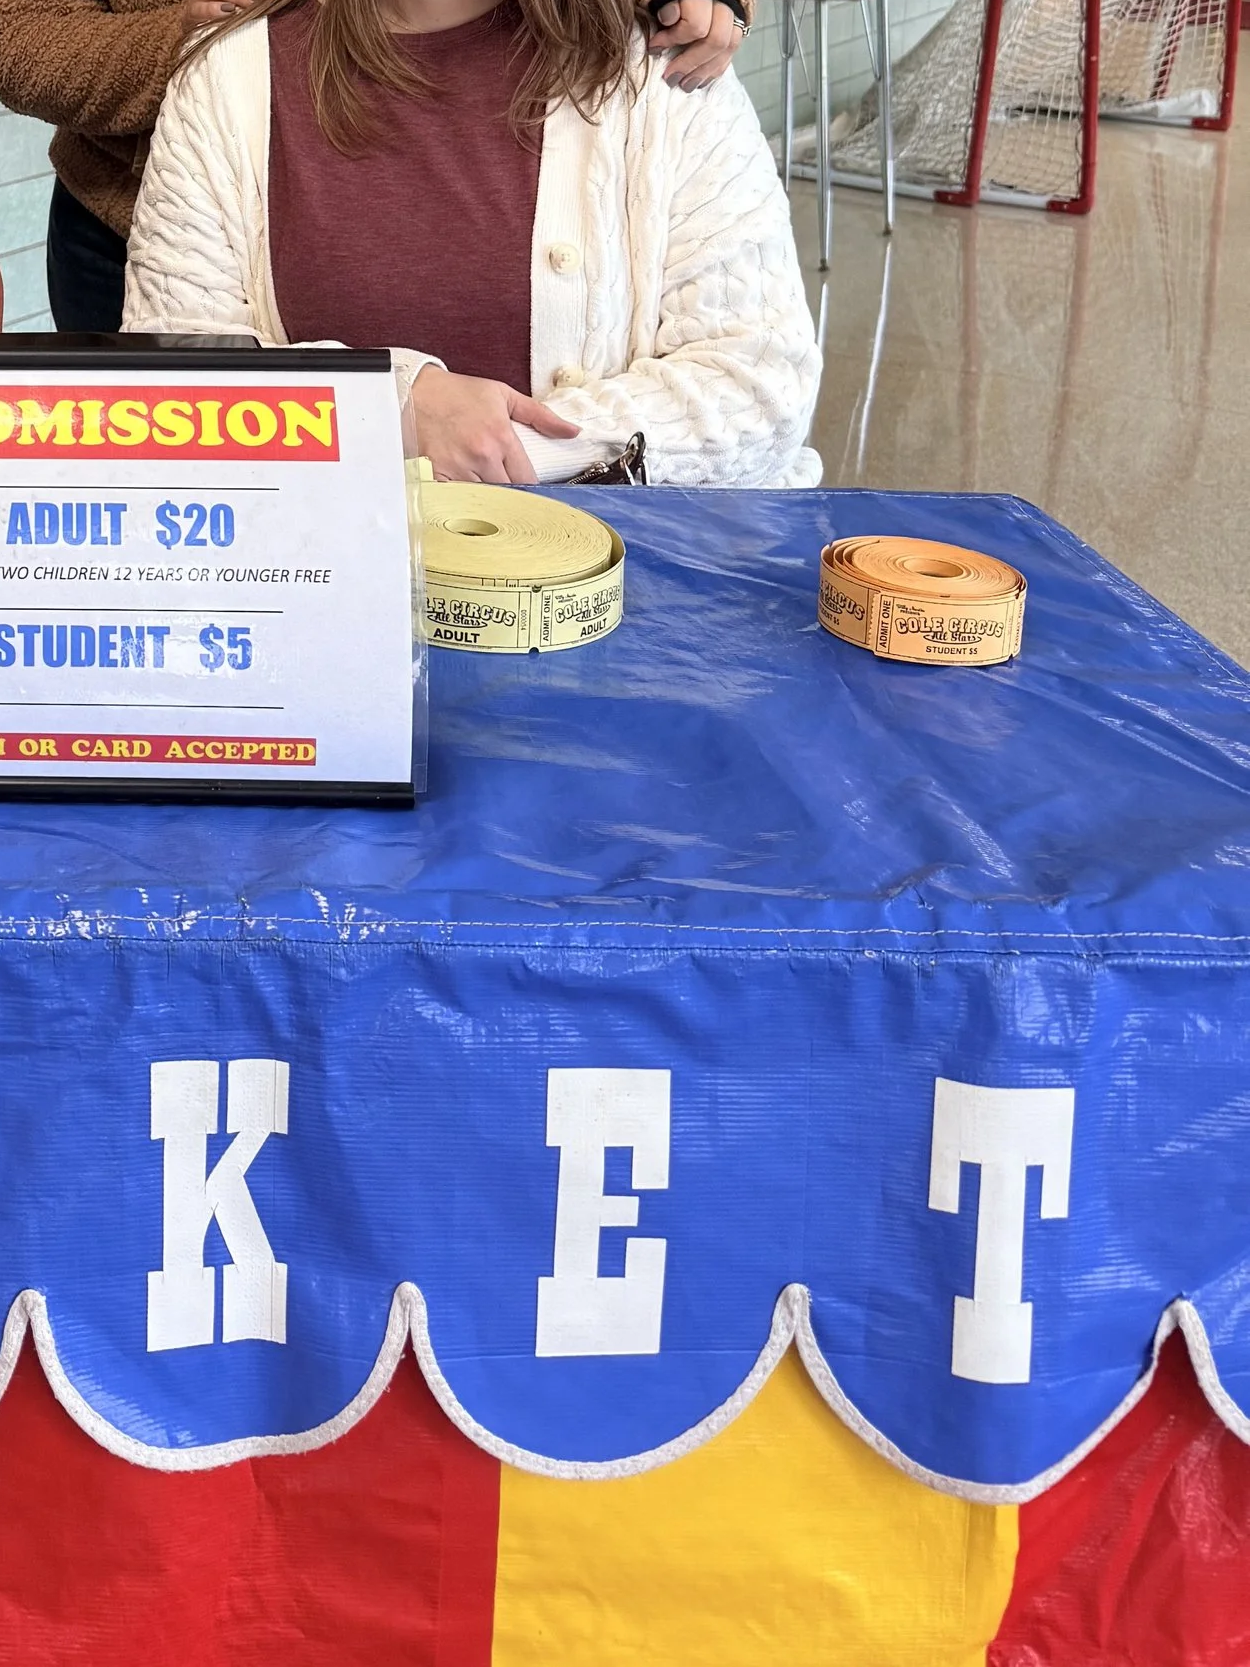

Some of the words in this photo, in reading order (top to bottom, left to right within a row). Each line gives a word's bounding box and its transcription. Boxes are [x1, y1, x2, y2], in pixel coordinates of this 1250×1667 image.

[6, 502, 128, 546] ADULT
[155, 500, 235, 550] $20
[34, 566, 110, 582] CHILDREN
[114, 567, 132, 582] 12
[138, 567, 185, 582] YEARS
[188, 568, 210, 582] OR
[215, 568, 291, 583] YOUNGER
[294, 568, 332, 584] FREE
[555, 596, 590, 624] COLE
[823, 581, 865, 621] IRCUS
[882, 600, 891, 619] ONE
[450, 600, 516, 626] CIRCUS
[453, 614, 480, 626] Stars
[433, 628, 480, 643] ADULT
[580, 618, 607, 638] ADULT
[879, 620, 889, 648] ADMIT
[895, 617, 944, 634] COLE
[948, 618, 1004, 638] CIRCUS
[950, 632, 976, 642] Stars
[199, 623, 252, 673] $5
[926, 646, 967, 654] STUDENT
[18, 738, 58, 757] OR
[72, 738, 152, 758] CARD
[165, 741, 316, 762] ACCEPTED
